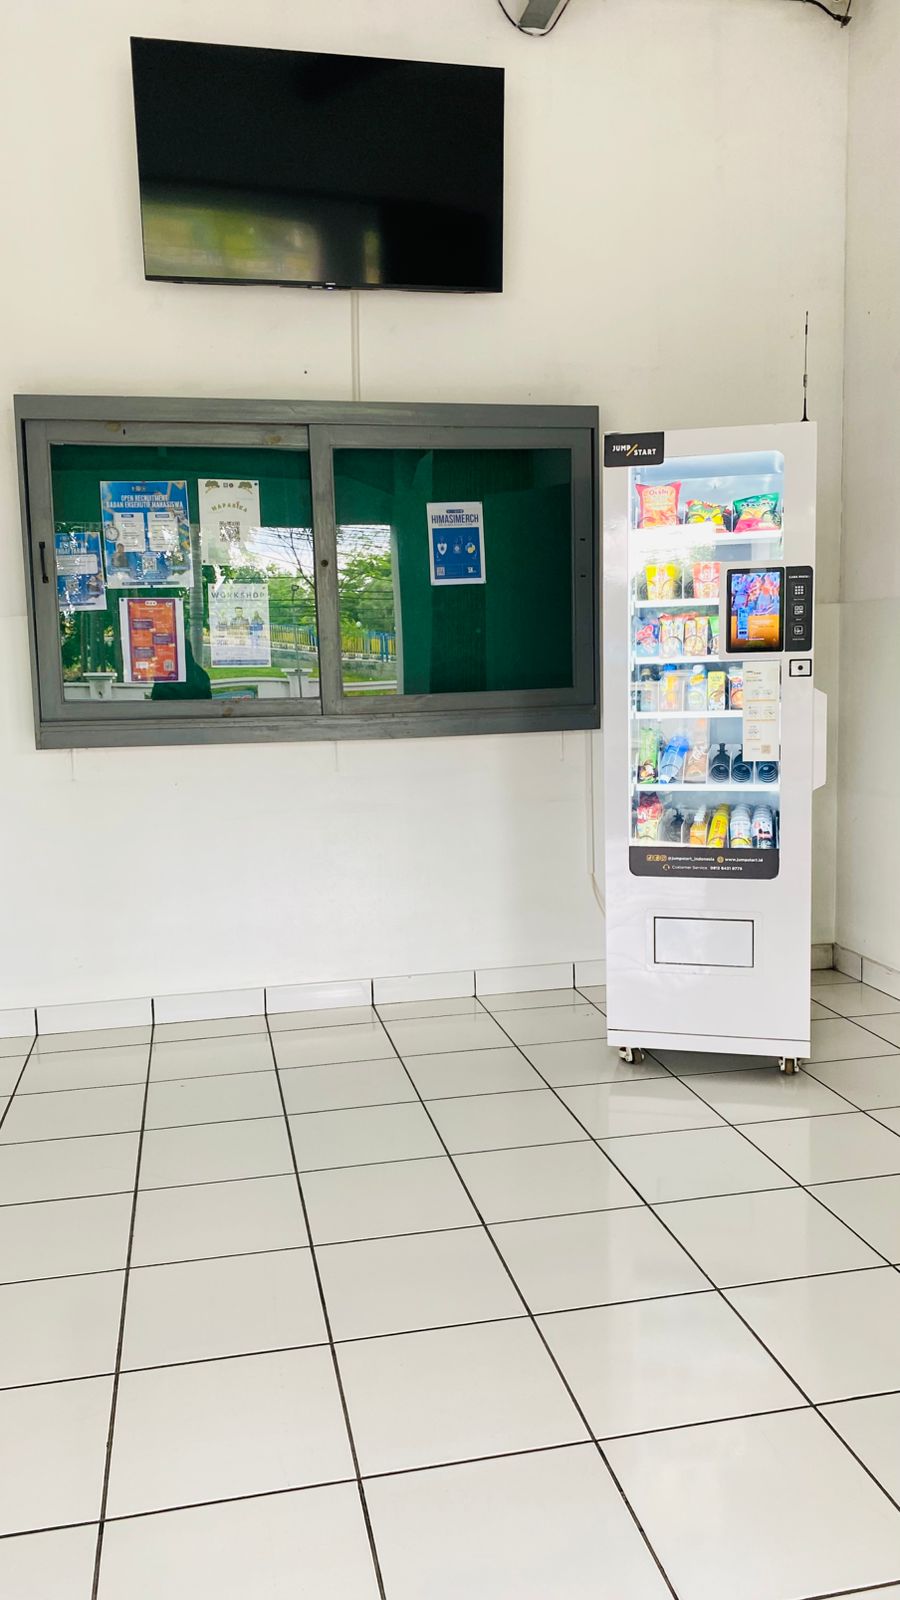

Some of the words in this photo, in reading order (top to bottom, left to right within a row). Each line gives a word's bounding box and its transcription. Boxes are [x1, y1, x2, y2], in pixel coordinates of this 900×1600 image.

[633, 448, 657, 456] START
[431, 514, 479, 523] HIMASIMERCH
[211, 591, 265, 599] WORKSHOP
